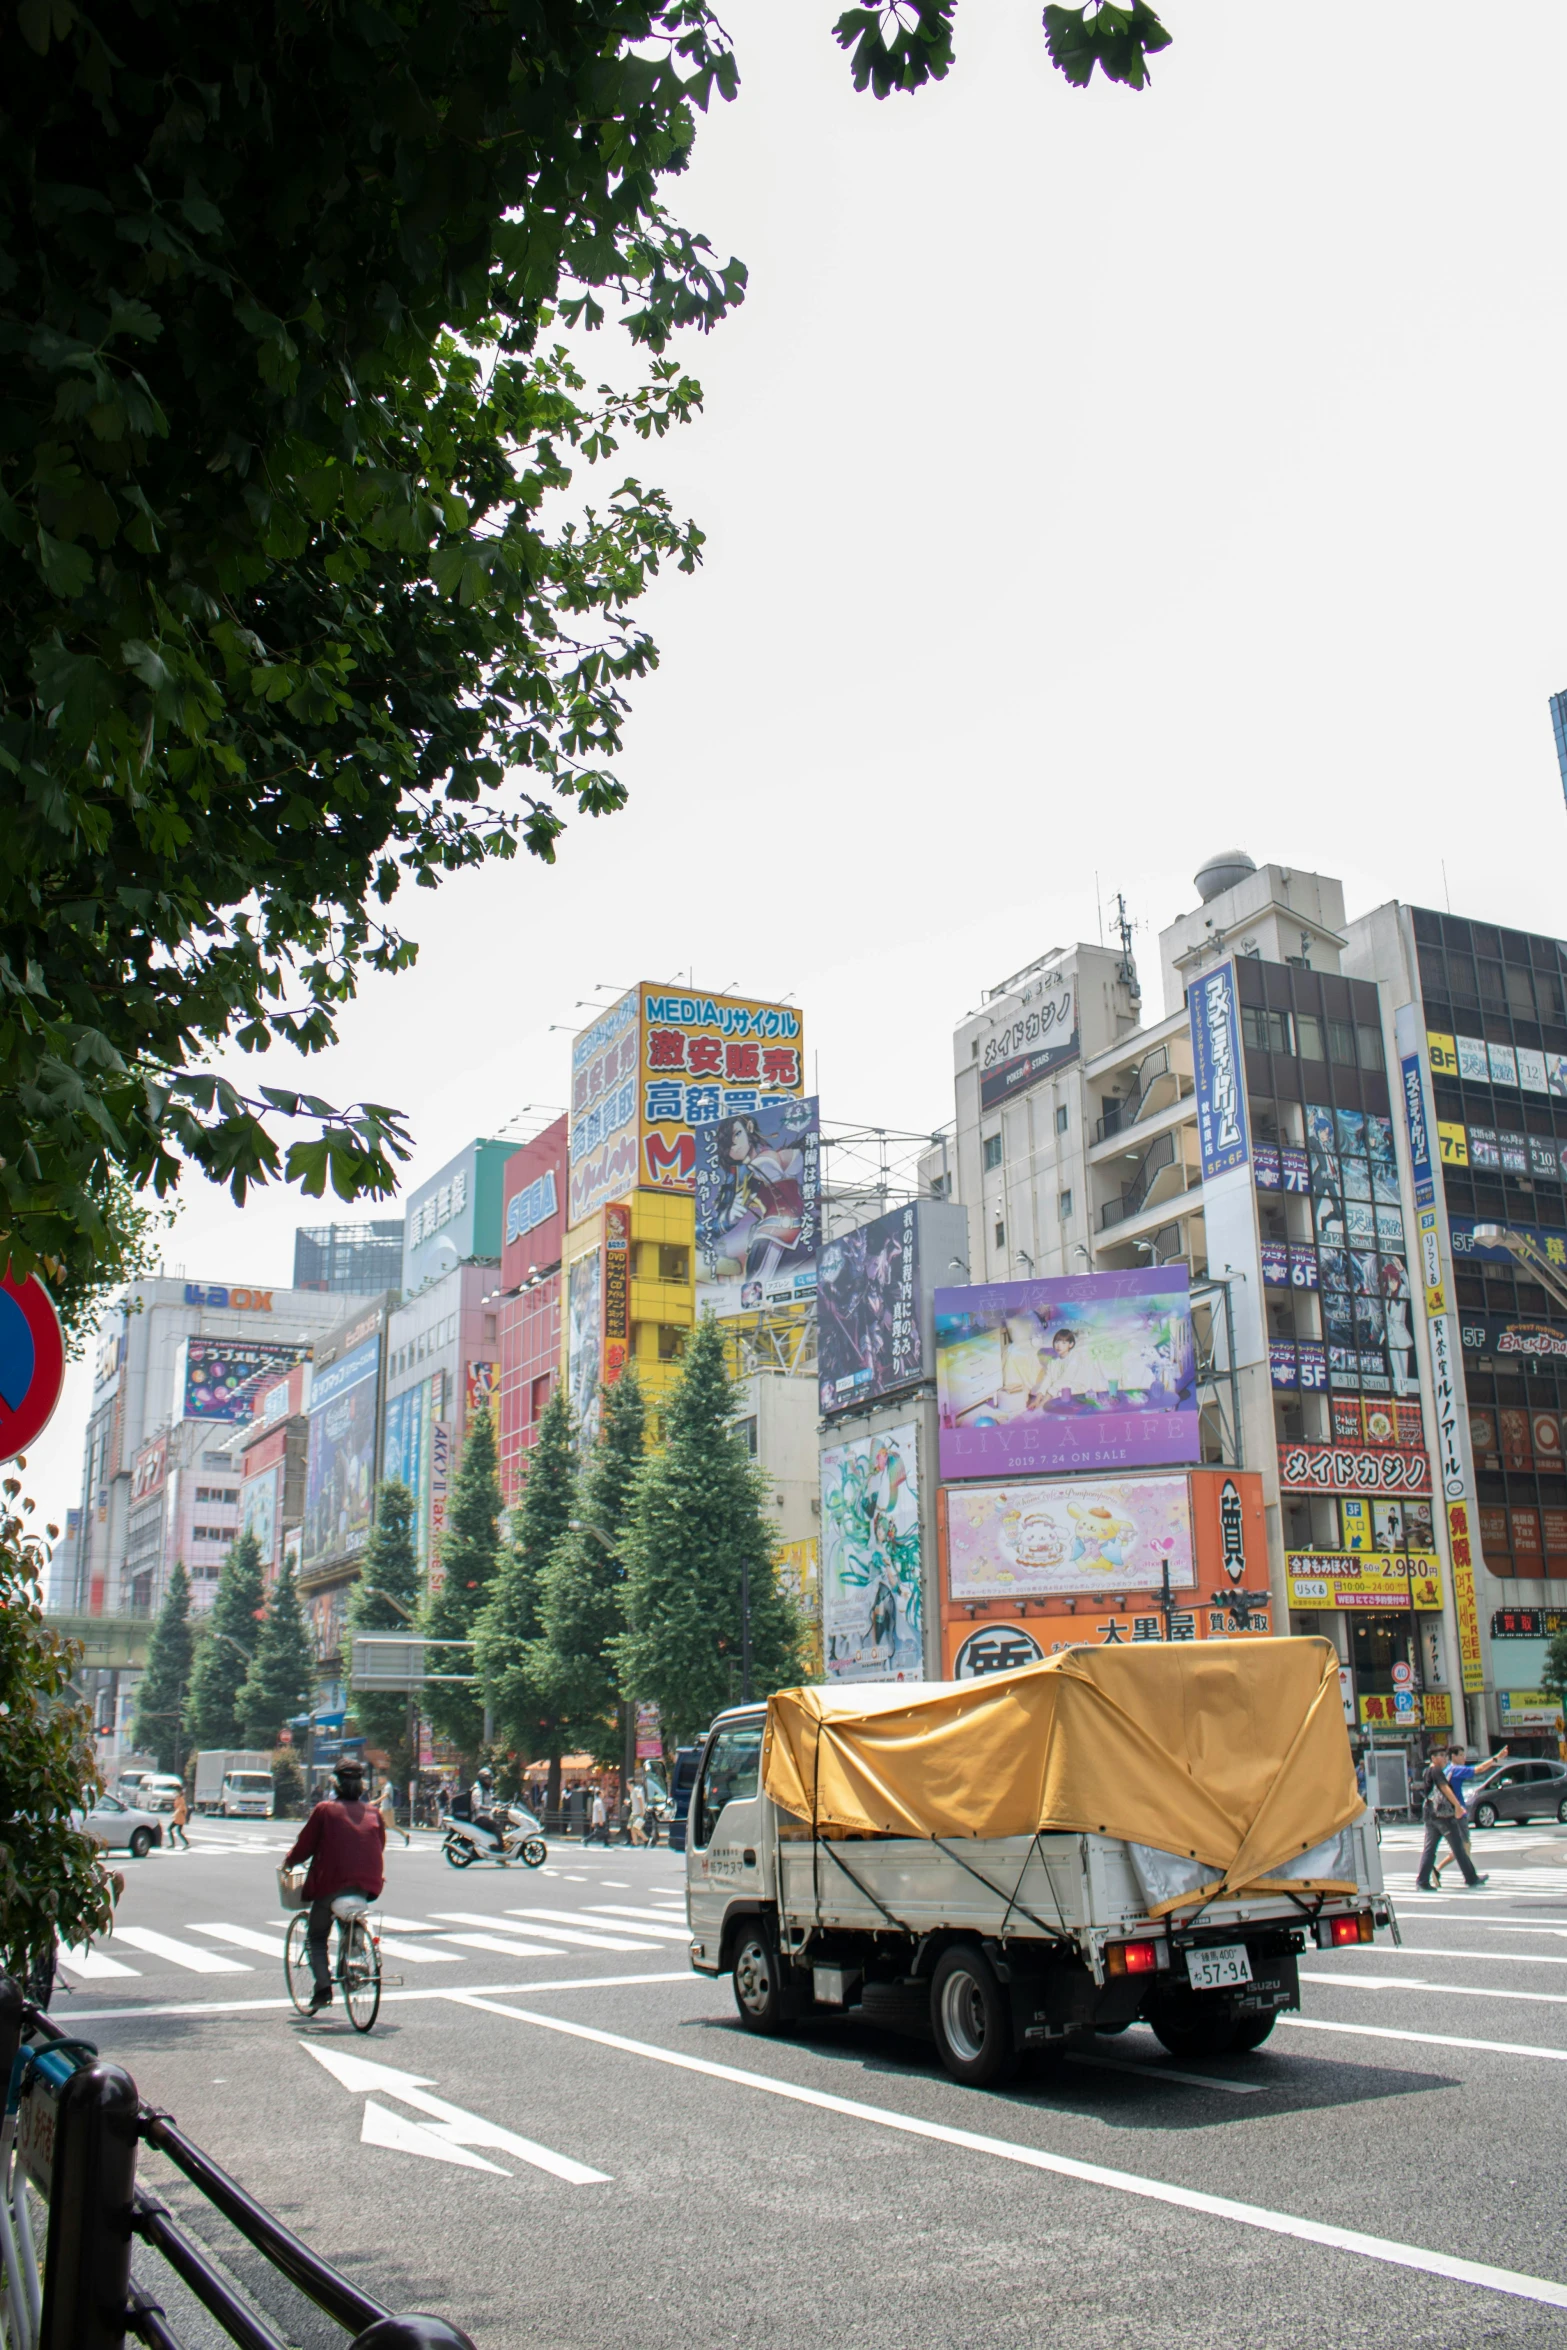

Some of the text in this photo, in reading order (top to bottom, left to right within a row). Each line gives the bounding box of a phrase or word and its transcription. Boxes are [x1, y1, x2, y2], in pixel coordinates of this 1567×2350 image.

[645, 996, 798, 1038] MEDIAリサイクル
[984, 992, 1071, 1068] メイドカジノ
[648, 1030, 798, 1085] 激安販売
[1206, 975, 1240, 1150] アメニティードリーム
[1430, 1046, 1455, 1068] 8F
[1006, 1052, 1050, 1085] POKER STARS
[1201, 1101, 1214, 1157] 秋葉原店
[703, 1129, 721, 1185] いつでも
[1439, 1136, 1466, 1159] 7F
[1539, 1152, 1552, 1167] 10
[1284, 1170, 1309, 1192] 7F
[800, 1132, 820, 1253] 準備は整ったぞ。
[506, 1169, 558, 1246] SEGA
[1422, 1215, 1434, 1228] 3F
[1329, 1233, 1340, 1245] 12
[1452, 1232, 1475, 1252] 5F
[608, 1252, 625, 1262] DVD
[1424, 1234, 1438, 1285] りらくる
[607, 1272, 625, 1280] ゲーム
[610, 1281, 623, 1290] CD
[901, 1209, 913, 1356] 我の射程内にのみ
[1292, 1265, 1317, 1287] 6F
[606, 1300, 625, 1309] アニメ
[607, 1290, 625, 1299] アイドル
[607, 1309, 625, 1318] コミック
[607, 1319, 624, 1328] ホビー
[891, 1302, 903, 1376] 真理あり
[1462, 1327, 1486, 1347] 5F
[1301, 1364, 1326, 1387] 5F
[1363, 1378, 1387, 1389] Stand
[955, 1416, 1184, 1455] LIVE A LIFE
[1336, 1425, 1359, 1436] Stars
[1071, 1452, 1091, 1463] ON
[1095, 1449, 1127, 1461] SALE
[1285, 1450, 1424, 1488] メイドカジノ
[1347, 1503, 1360, 1515] 3F
[1345, 1520, 1365, 1532] 入口
[1515, 1526, 1533, 1537] Tax
[1450, 1506, 1472, 1568] 免税
[1515, 1538, 1537, 1549] Free
[1291, 1557, 1359, 1574] 全身もみほぐし
[1363, 1563, 1380, 1572] 60分
[1296, 1584, 1325, 1595] りらくる
[1465, 1572, 1475, 1608] TAX
[1503, 1614, 1532, 1631] 買取
[1469, 1613, 1481, 1660] FREE
[1430, 1635, 1441, 1683] ルノアール
[1396, 1668, 1407, 1678] 40
[1425, 1695, 1446, 1712] FREE
[1219, 1948, 1235, 1960] 400
[1202, 1960, 1248, 1985] 57-94
[1246, 1979, 1281, 1992] ISUZU
